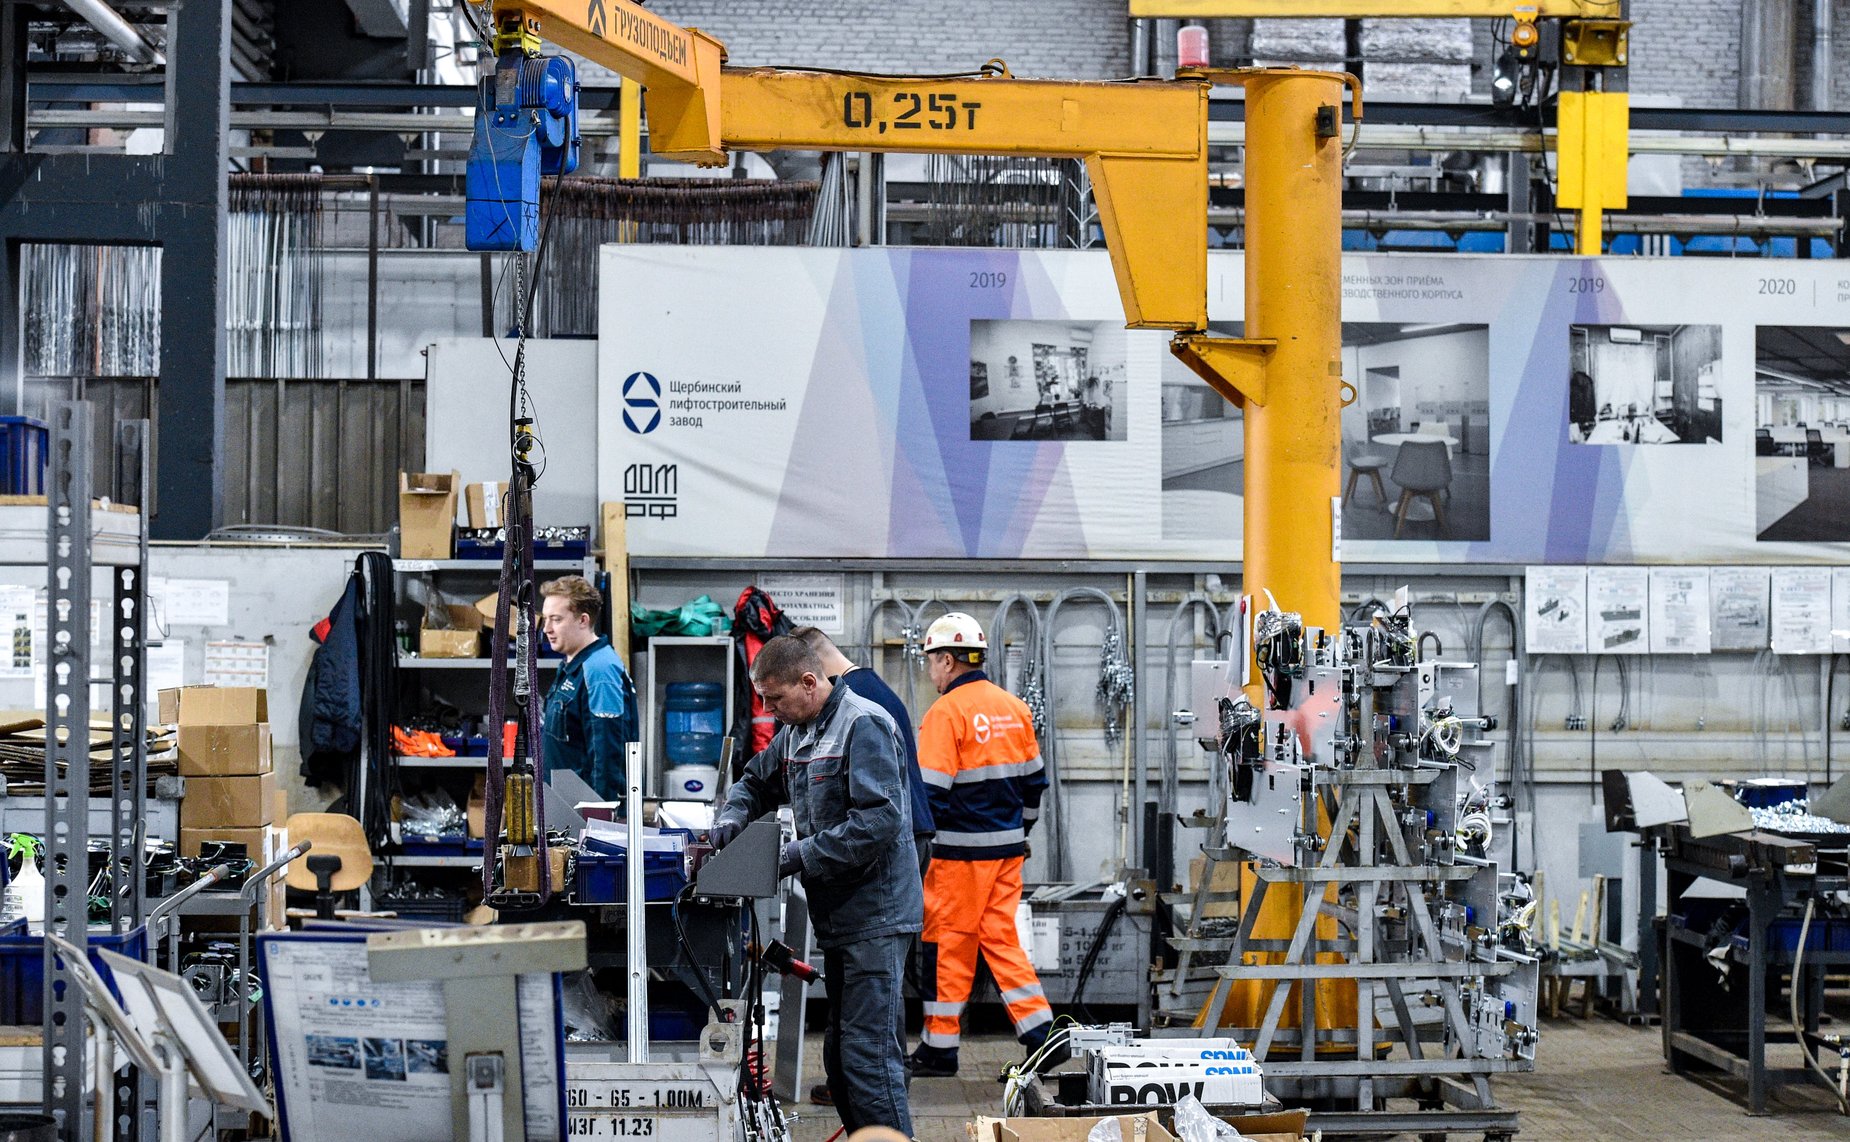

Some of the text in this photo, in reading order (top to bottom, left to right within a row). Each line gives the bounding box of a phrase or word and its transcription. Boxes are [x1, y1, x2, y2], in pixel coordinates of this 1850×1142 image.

[614, 5, 687, 67] ГРУЗОПОДЪЕМ
[969, 272, 1007, 288] 2019
[1342, 275, 1445, 287] МЕННЫХ ЗОН ПРИЁМА
[1568, 277, 1605, 294] 2019
[1758, 278, 1796, 295] 2020
[1837, 280, 1850, 290] КО
[1342, 289, 1464, 300] ЗВОДСТВЕННОГО КОРПУСА
[1837, 293, 1850, 303] ПР
[669, 380, 742, 394] Щербинский
[669, 398, 787, 412] лифтостроительный
[669, 416, 703, 428] завод
[624, 464, 677, 494] ДОМ
[624, 503, 677, 521] РФ
[1076, 941, 1108, 952] 100
[568, 1117, 653, 1136] ИЗГ. 11.23
